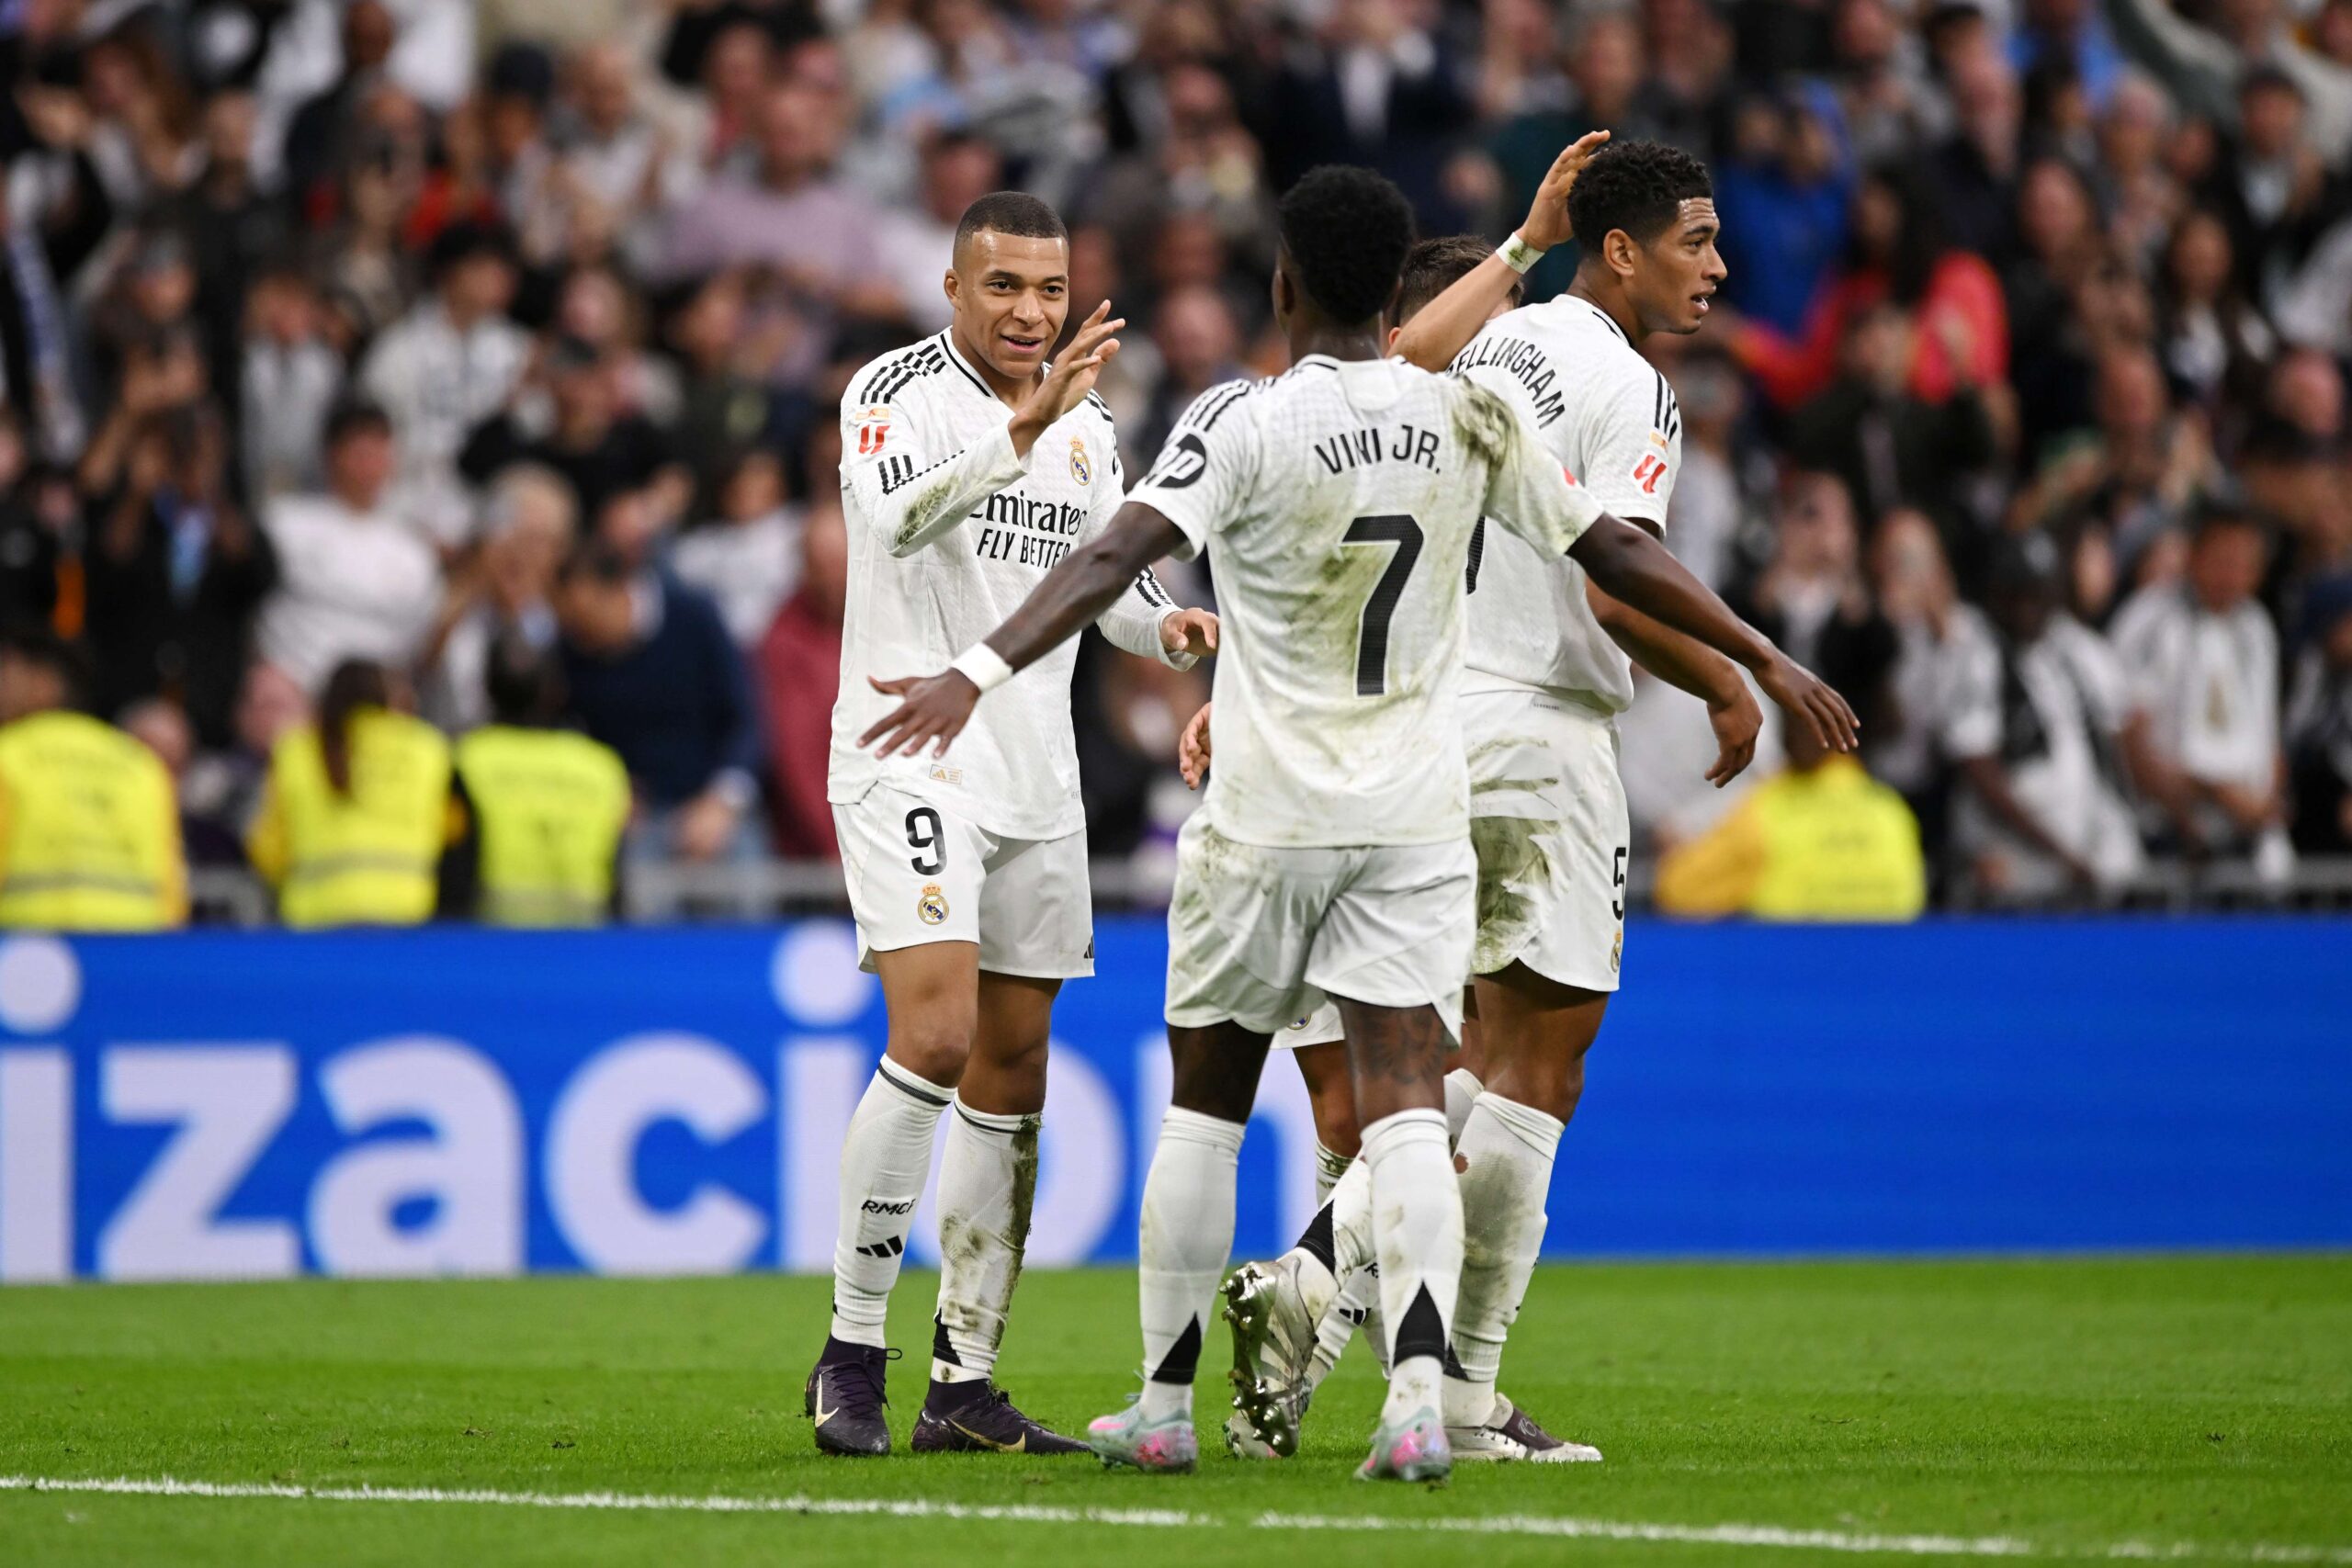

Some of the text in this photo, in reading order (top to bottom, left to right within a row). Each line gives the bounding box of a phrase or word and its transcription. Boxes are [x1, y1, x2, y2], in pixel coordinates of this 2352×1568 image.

[1445, 337, 1566, 430] ELLINGHAM
[1315, 424, 1441, 475] VINI JR.
[969, 490, 1087, 536] mirates
[977, 528, 1015, 560] FLY
[1342, 514, 1424, 696] 7
[905, 807, 947, 875] 9
